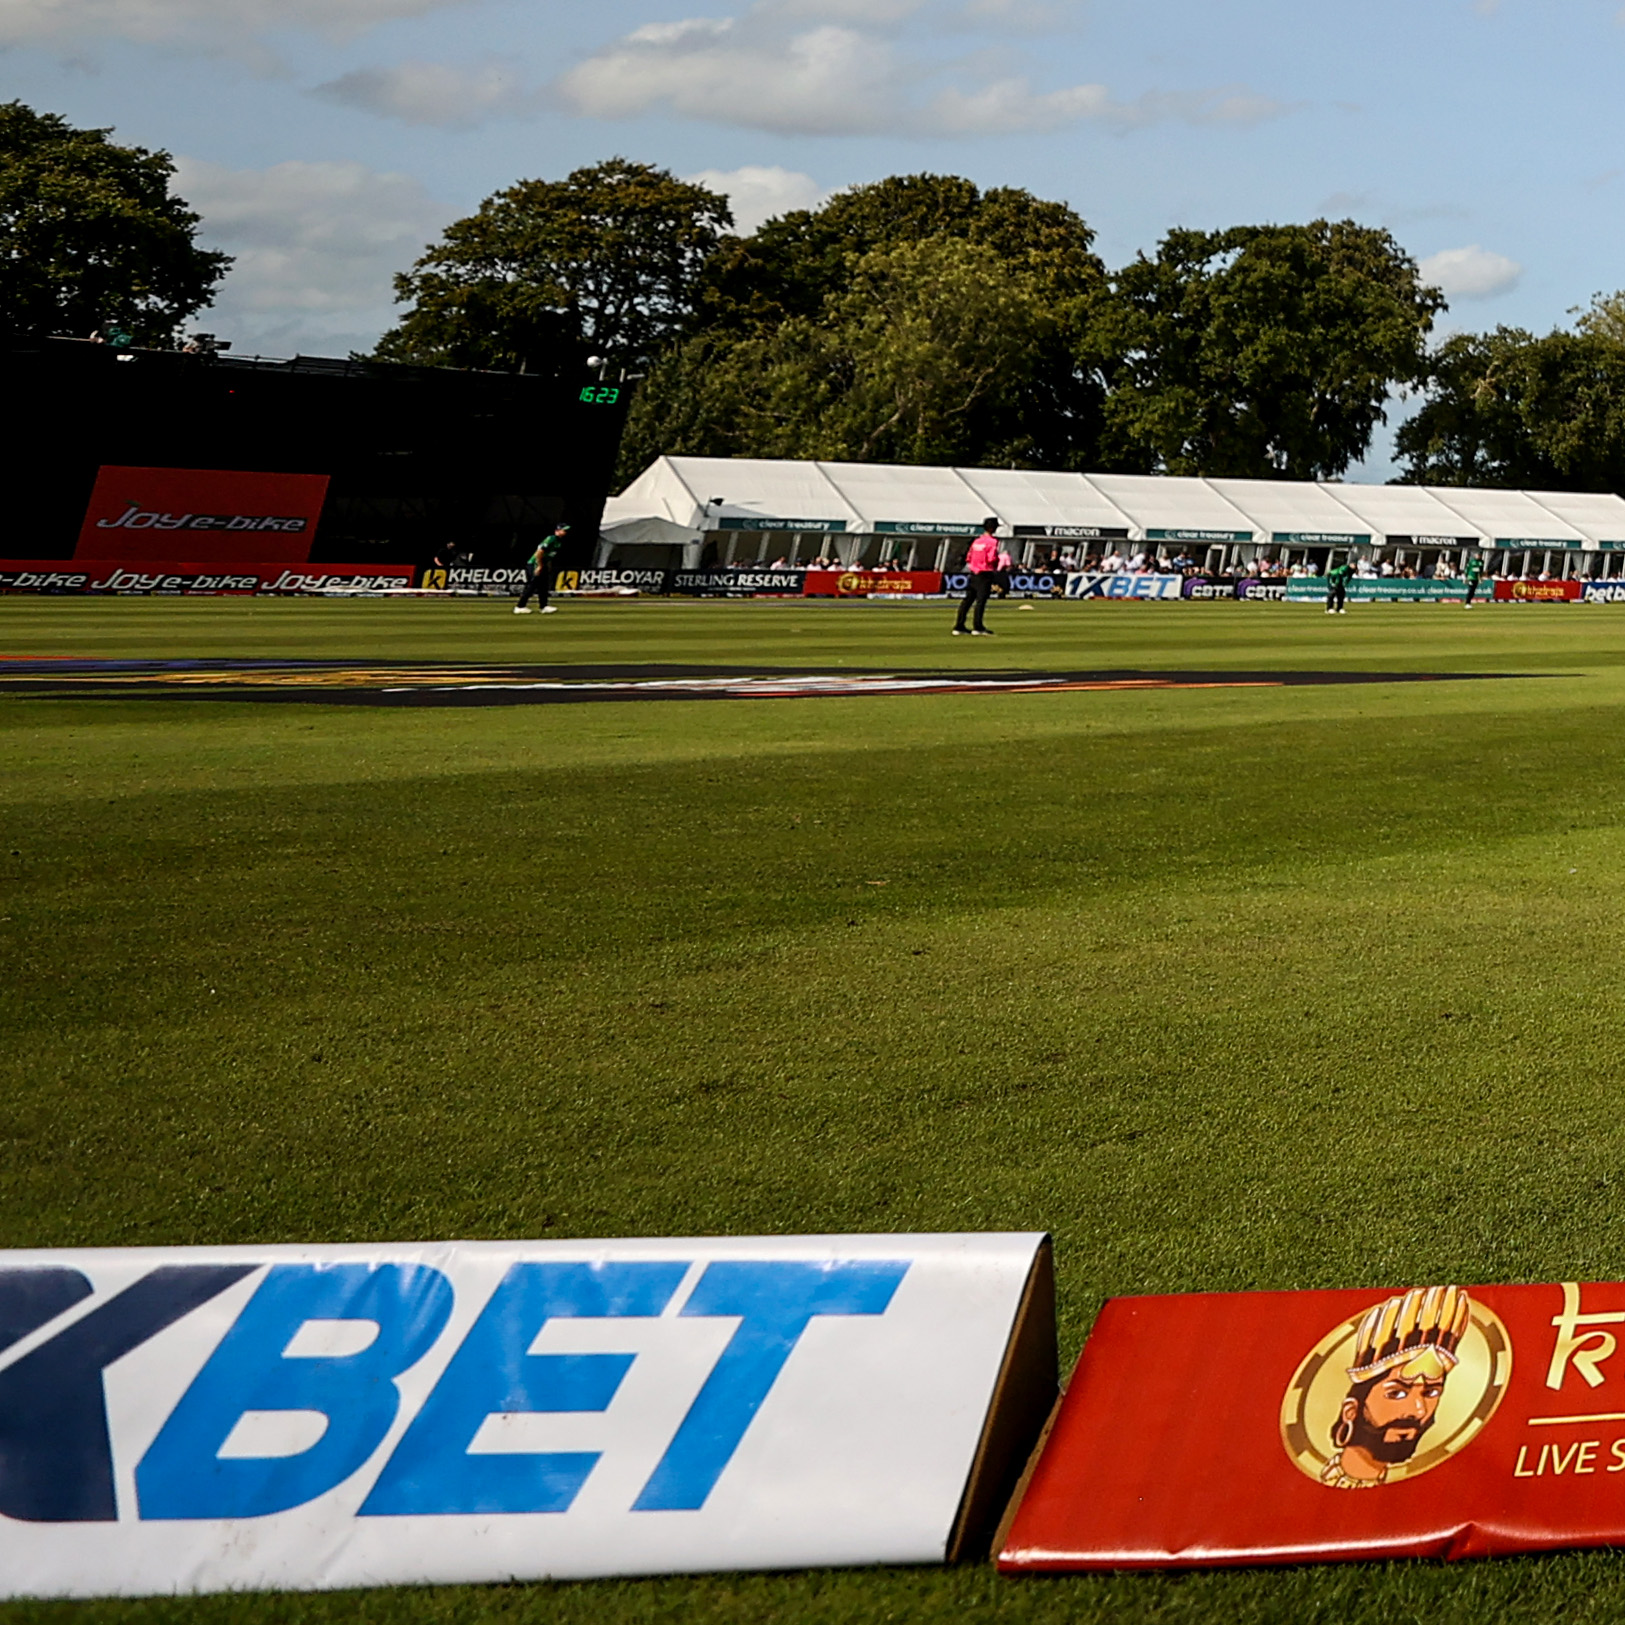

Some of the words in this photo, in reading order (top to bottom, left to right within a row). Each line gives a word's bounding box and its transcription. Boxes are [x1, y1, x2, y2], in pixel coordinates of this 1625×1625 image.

[1055, 527, 1100, 537] macron
[1418, 536, 1457, 546] macron
[450, 568, 528, 584] KHELOYA
[580, 569, 664, 585] KHELOYAR
[674, 573, 736, 588] STERLING
[737, 574, 799, 588] RESERVE
[1068, 576, 1177, 598] 1XBET
[1514, 1439, 1598, 1479] LIVE
